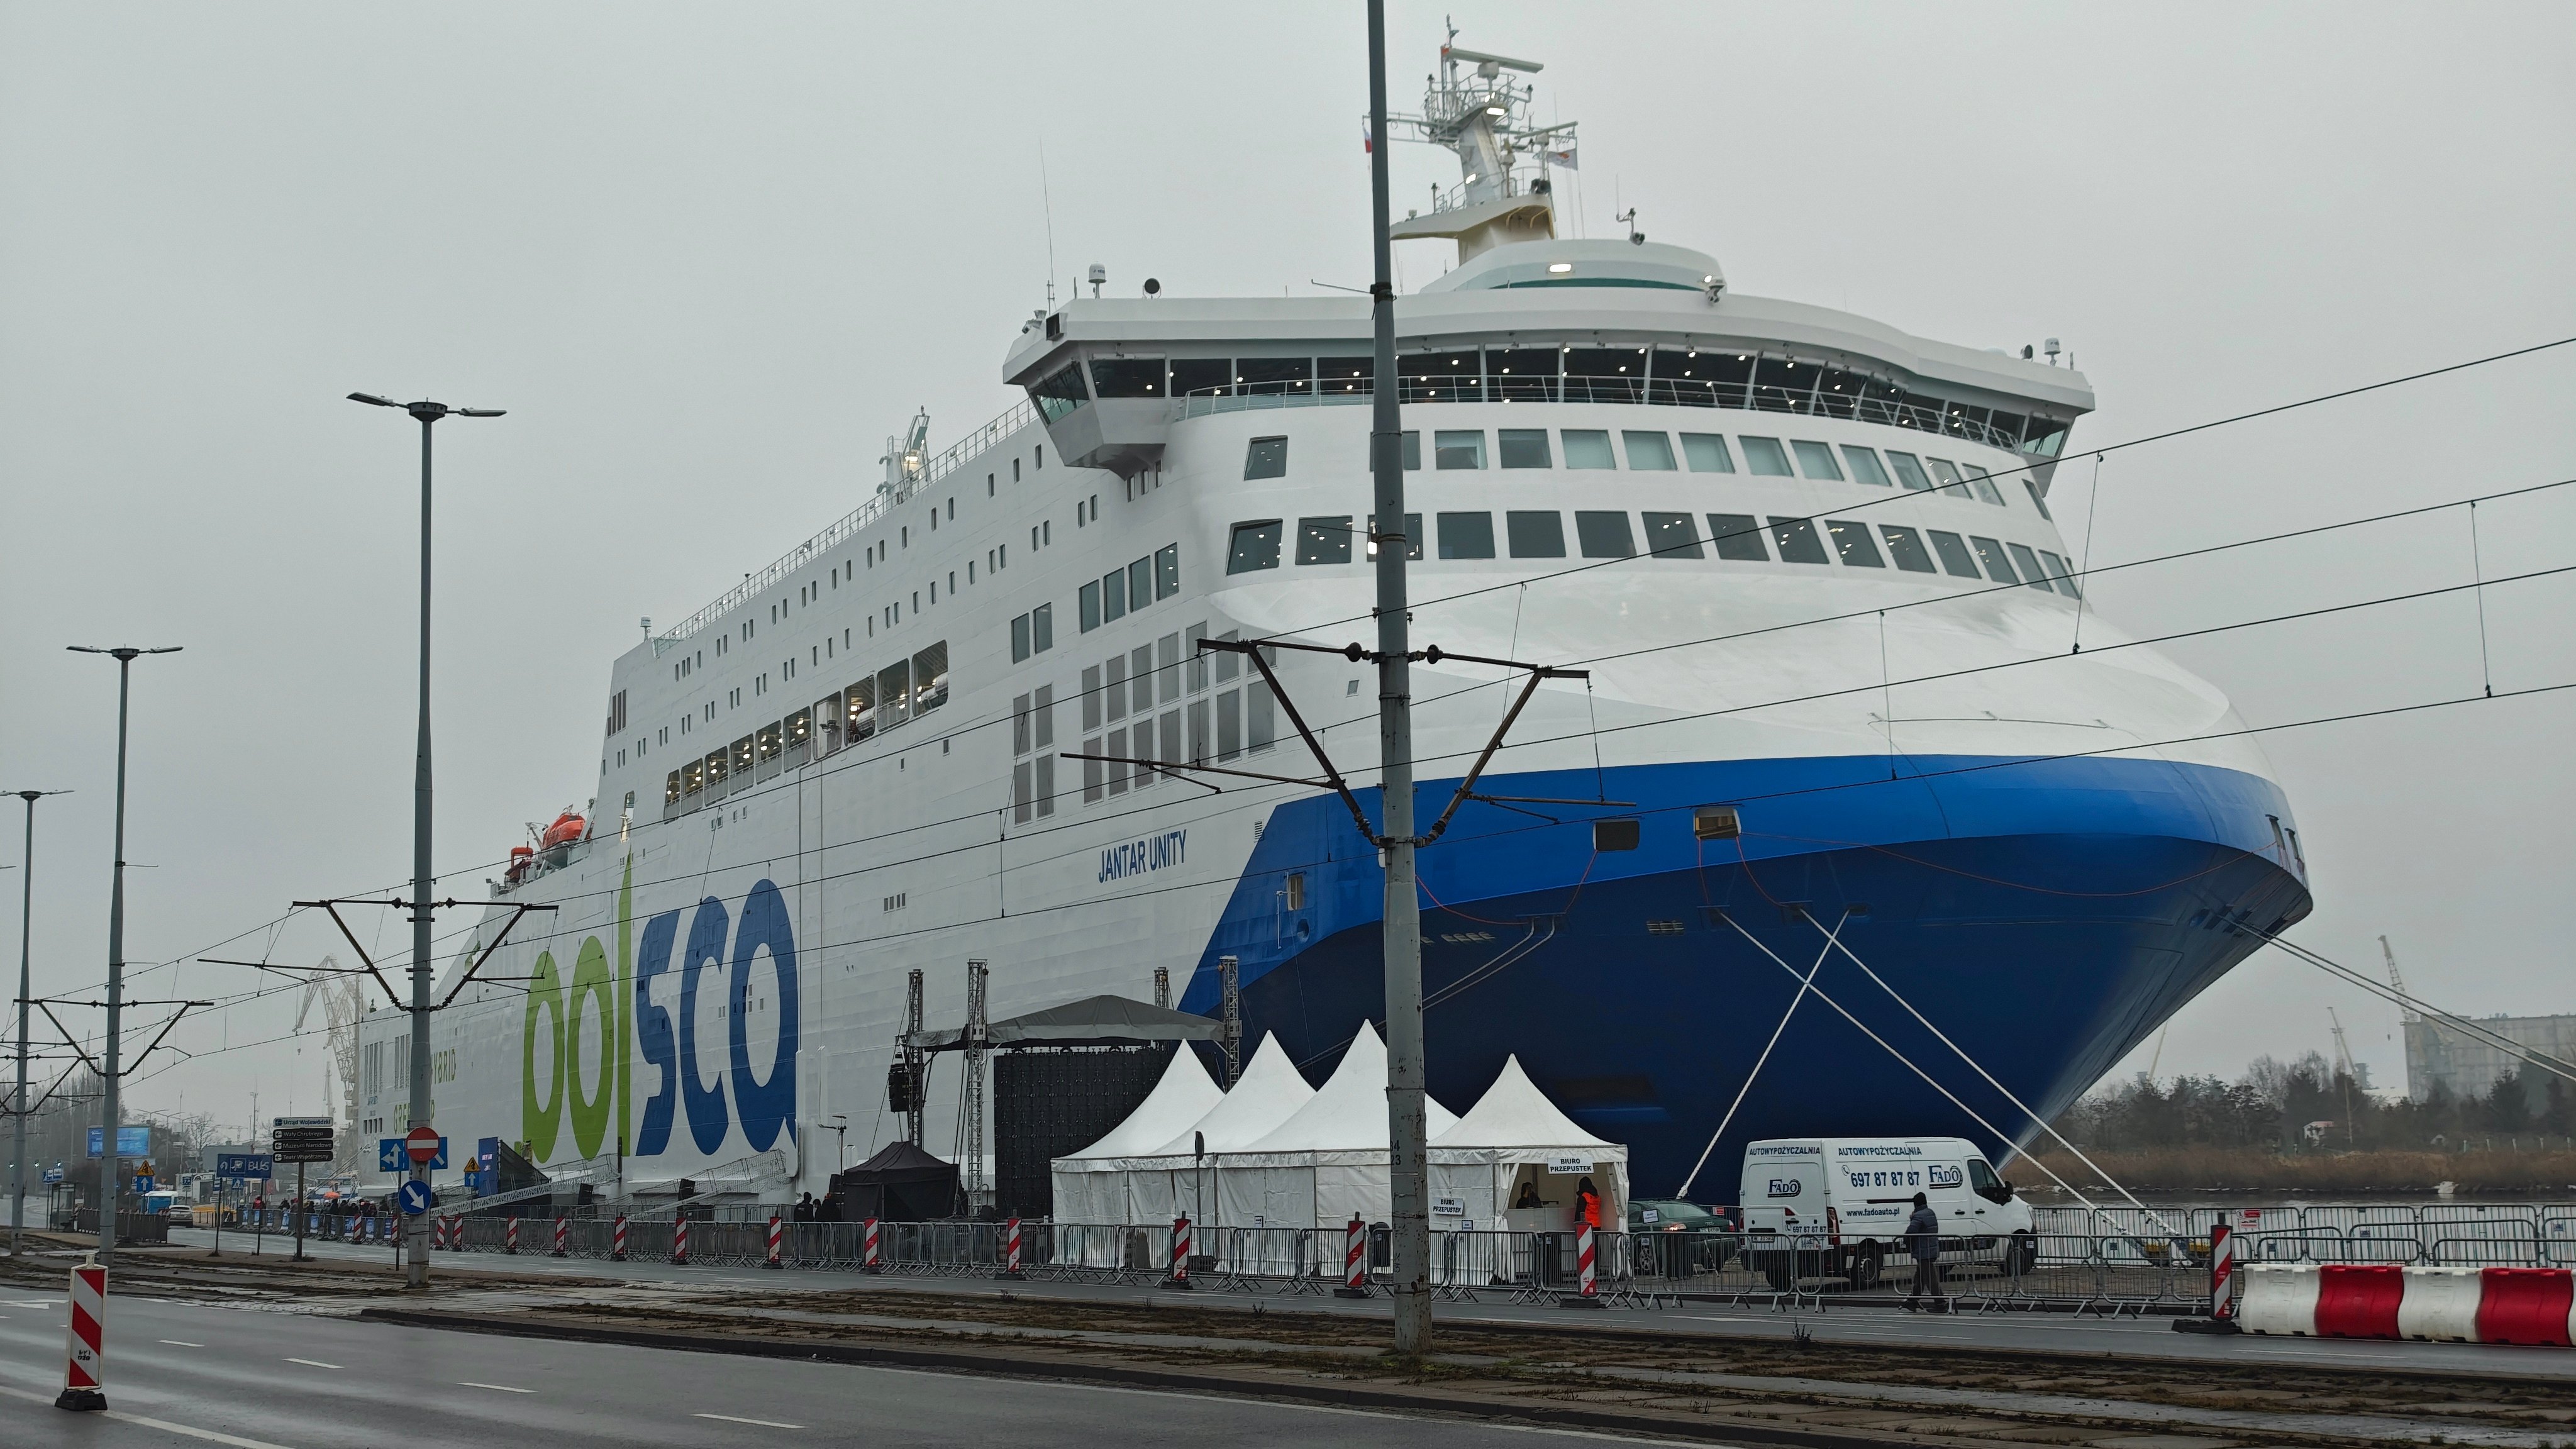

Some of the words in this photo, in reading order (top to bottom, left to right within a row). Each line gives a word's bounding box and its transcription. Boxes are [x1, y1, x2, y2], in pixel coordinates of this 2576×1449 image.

[1099, 841, 1146, 883] JANTAR
[1150, 829, 1187, 870] UNITY
[1749, 1145, 1821, 1156] AUTOWYPOŻYCZALNIA
[1838, 1145, 1922, 1156] AUTOWYPOŻYCZALNIA
[248, 1161, 269, 1171] BUS
[1851, 1172, 1870, 1187] 697
[1874, 1172, 1887, 1186] 87
[1891, 1172, 1903, 1186] 87
[1907, 1171, 1920, 1185] 87
[1846, 1207, 1900, 1217] www.fadoauto.pl
